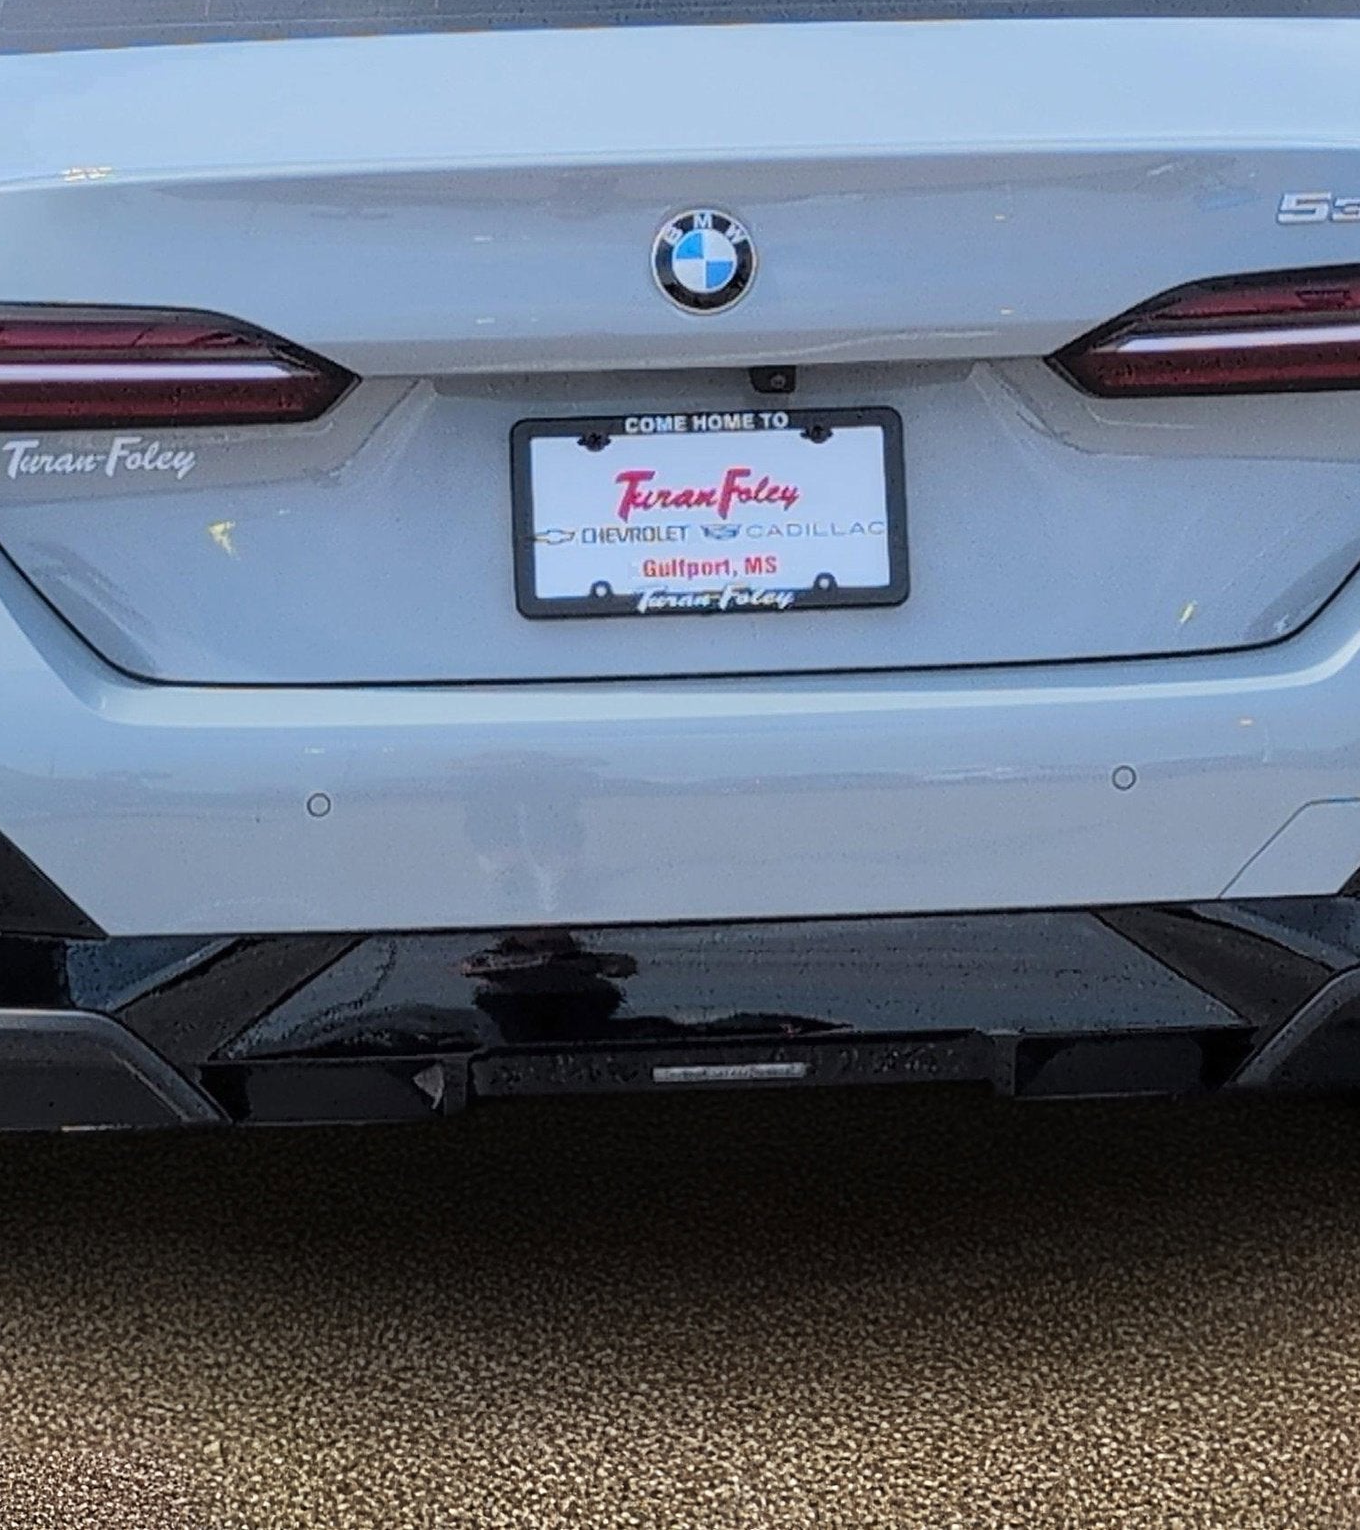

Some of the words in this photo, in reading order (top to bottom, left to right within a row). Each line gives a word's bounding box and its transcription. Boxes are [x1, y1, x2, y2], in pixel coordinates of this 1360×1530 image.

[624, 415, 687, 433] COME
[692, 412, 755, 431] HOME
[759, 410, 789, 429] TO
[615, 470, 719, 523] Turan
[715, 467, 800, 521] Foley
[581, 524, 690, 545] CHEVROLET
[745, 520, 886, 538] CADILLAC
[642, 557, 739, 580] Gulfport,
[744, 555, 779, 575] MS
